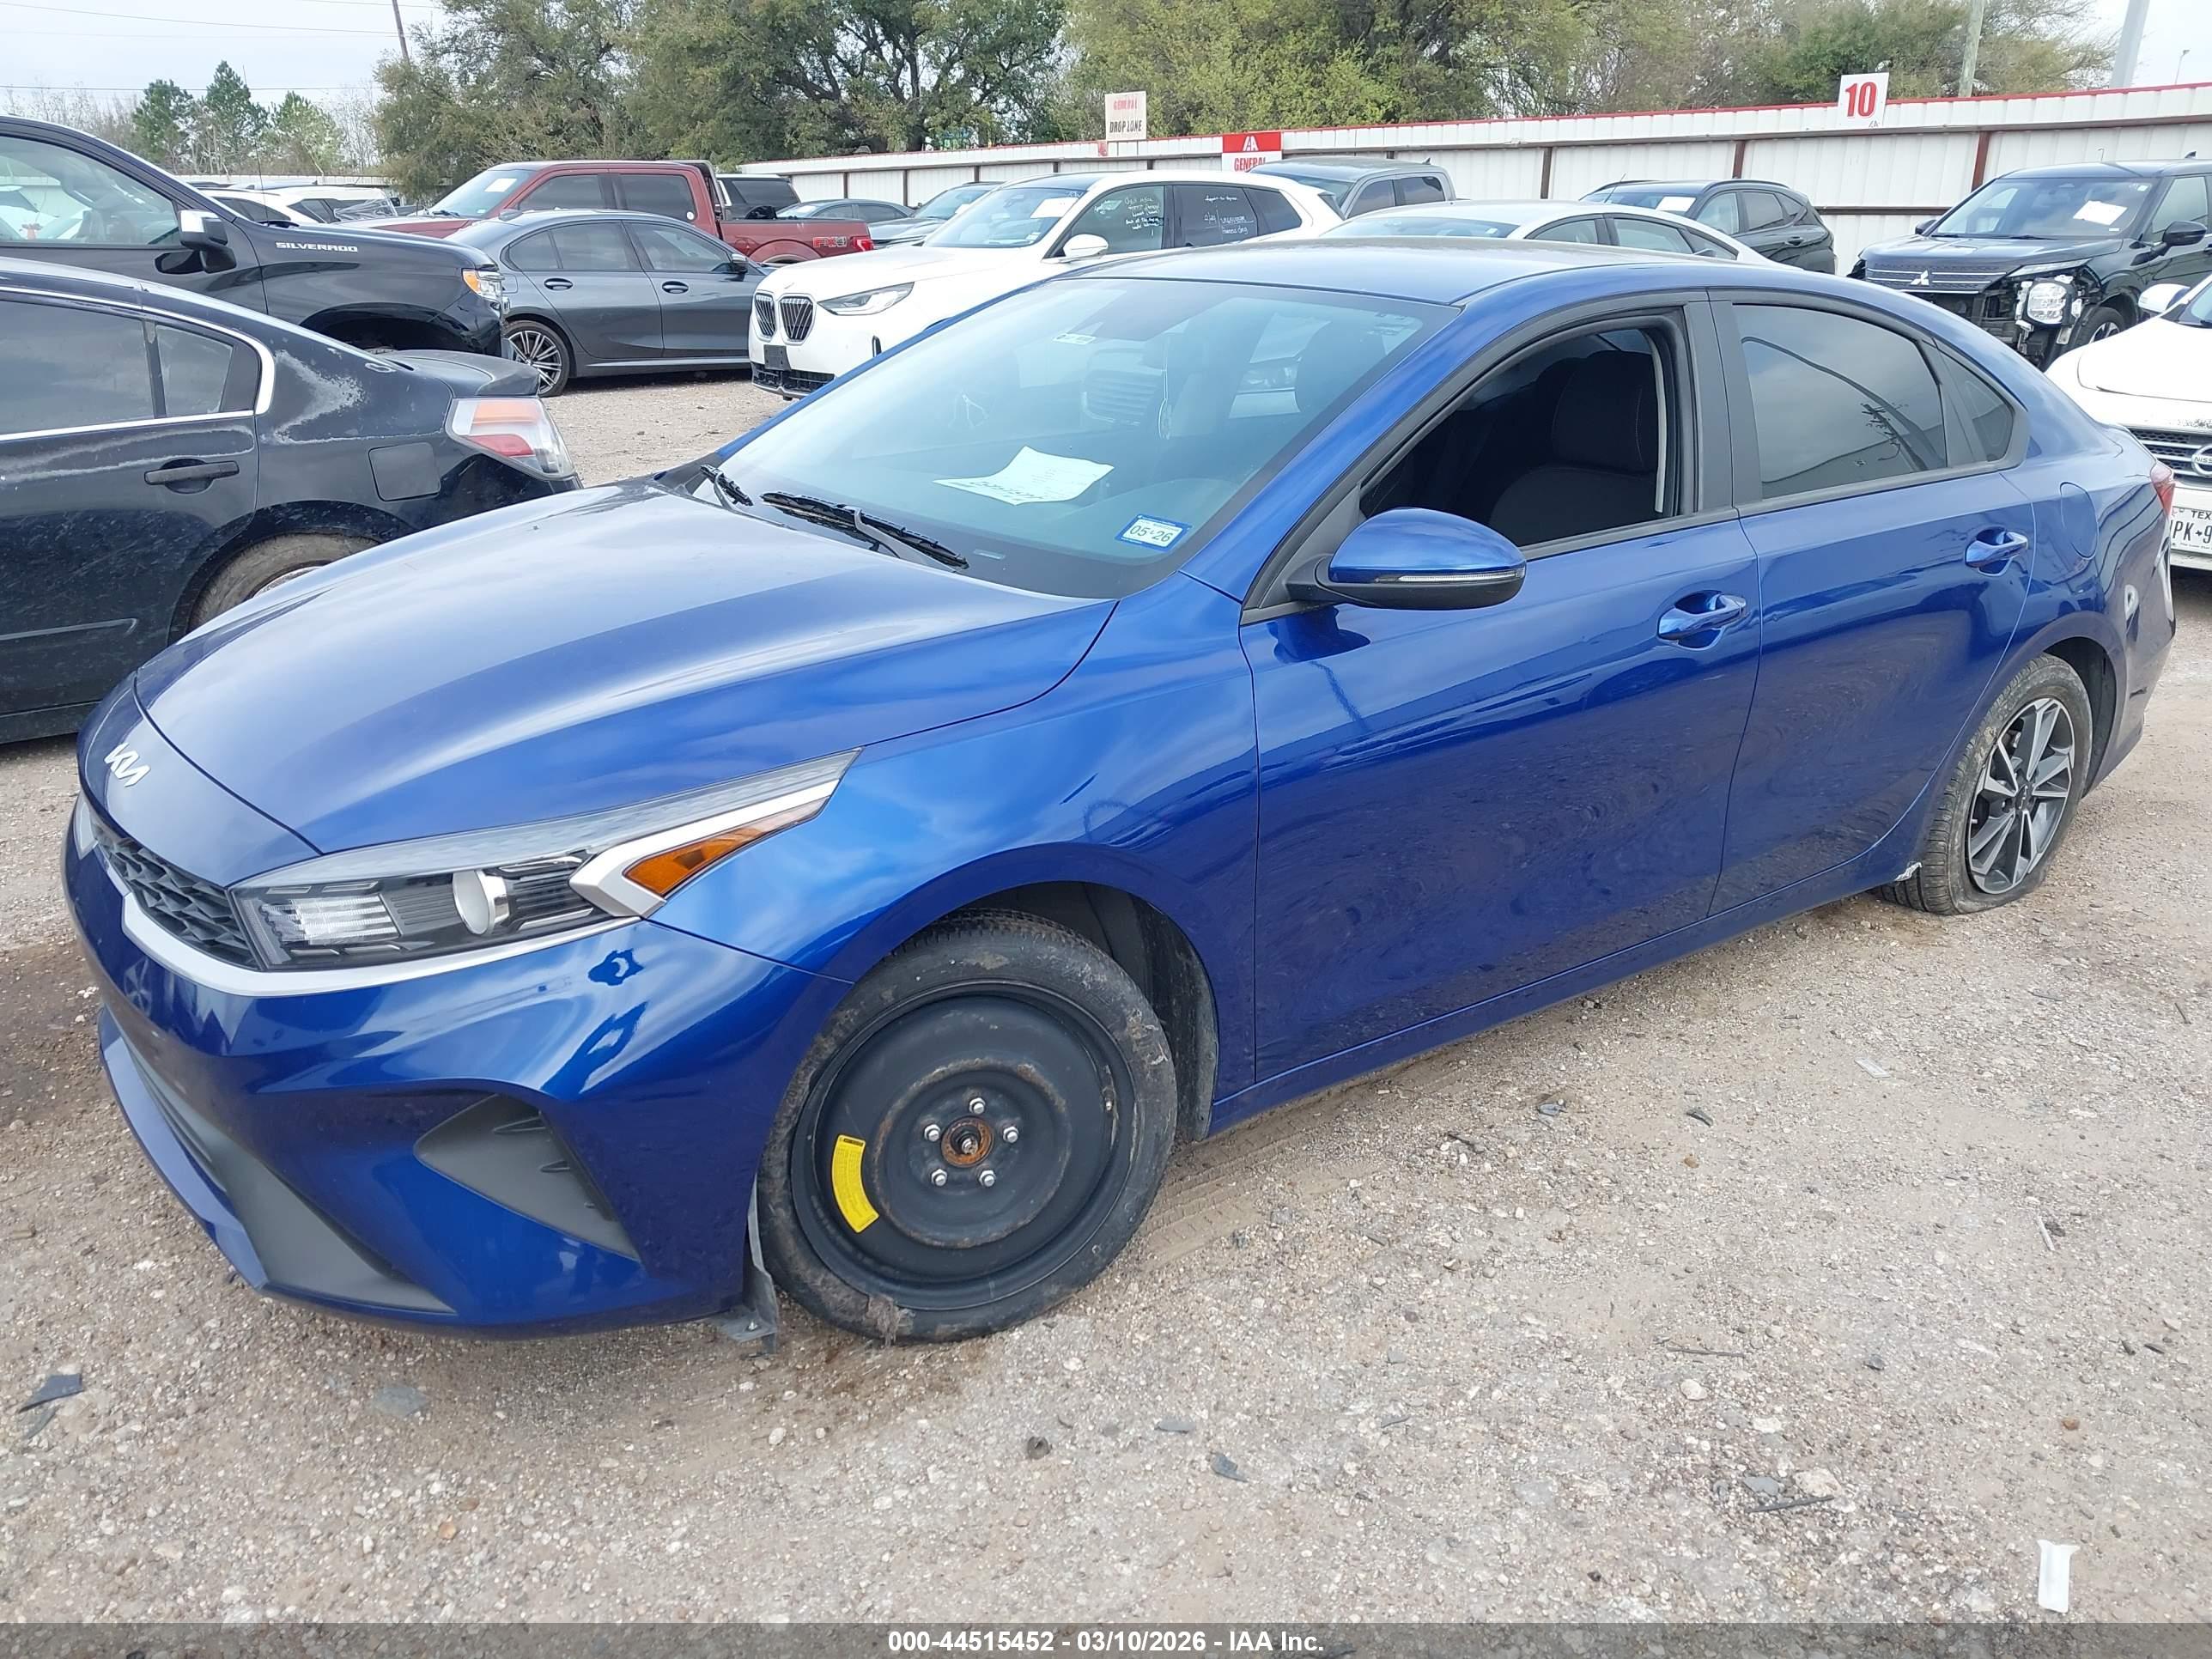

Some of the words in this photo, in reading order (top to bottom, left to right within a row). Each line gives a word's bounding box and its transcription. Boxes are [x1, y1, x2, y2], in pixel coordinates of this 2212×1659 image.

[1845, 82, 1877, 117] 10
[1109, 121, 1126, 133] DROP
[1127, 120, 1142, 132] ZONE
[276, 242, 358, 252] SILVERADO
[104, 742, 151, 787] KIA
